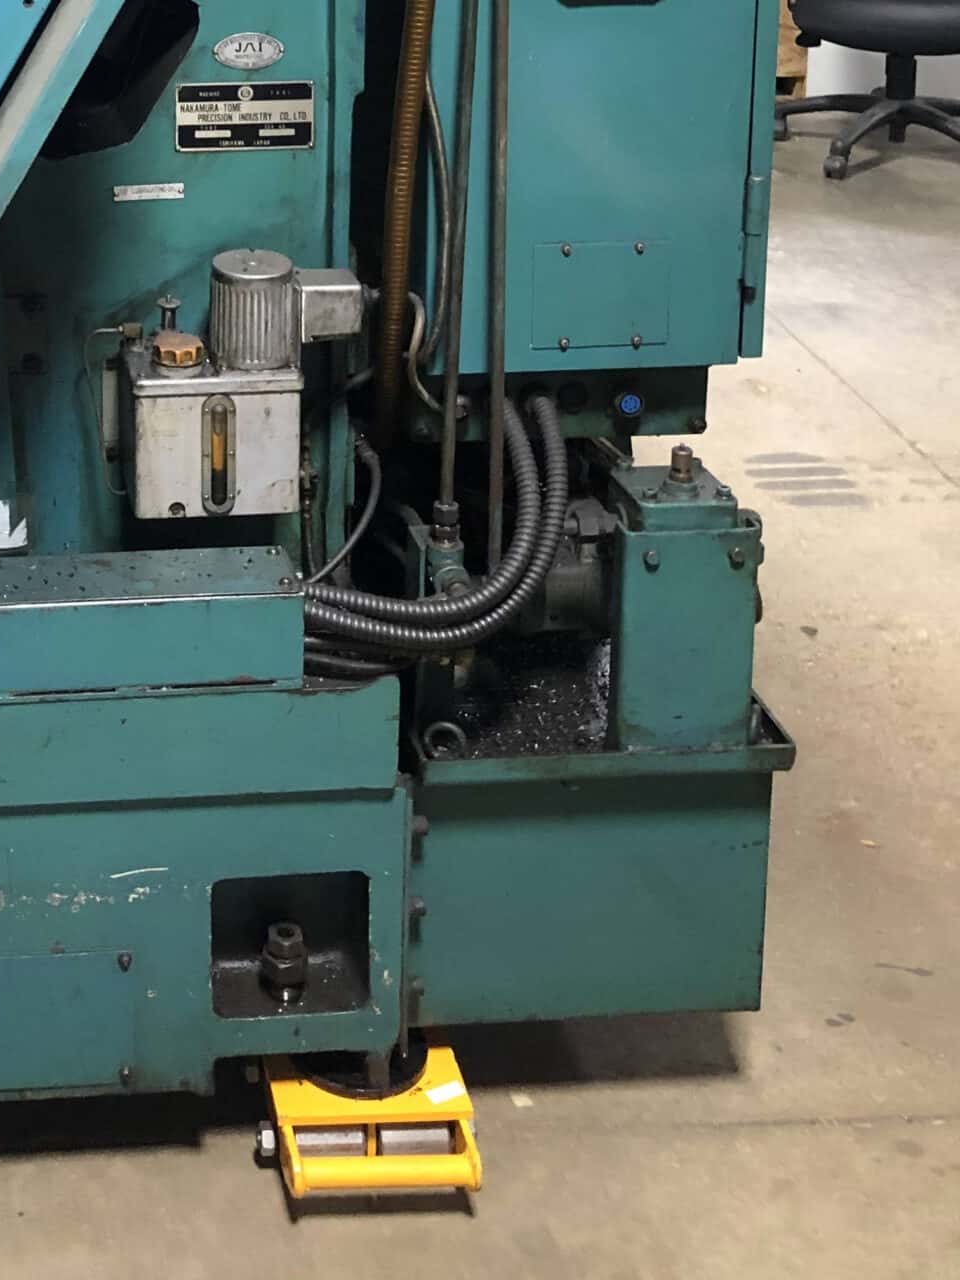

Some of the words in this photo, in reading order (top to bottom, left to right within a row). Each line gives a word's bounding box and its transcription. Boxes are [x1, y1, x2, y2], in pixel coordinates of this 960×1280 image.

[180, 103, 219, 113] NAKAMURA
[197, 113, 233, 122] PRECISION
[238, 112, 272, 121] INDUSTRY
